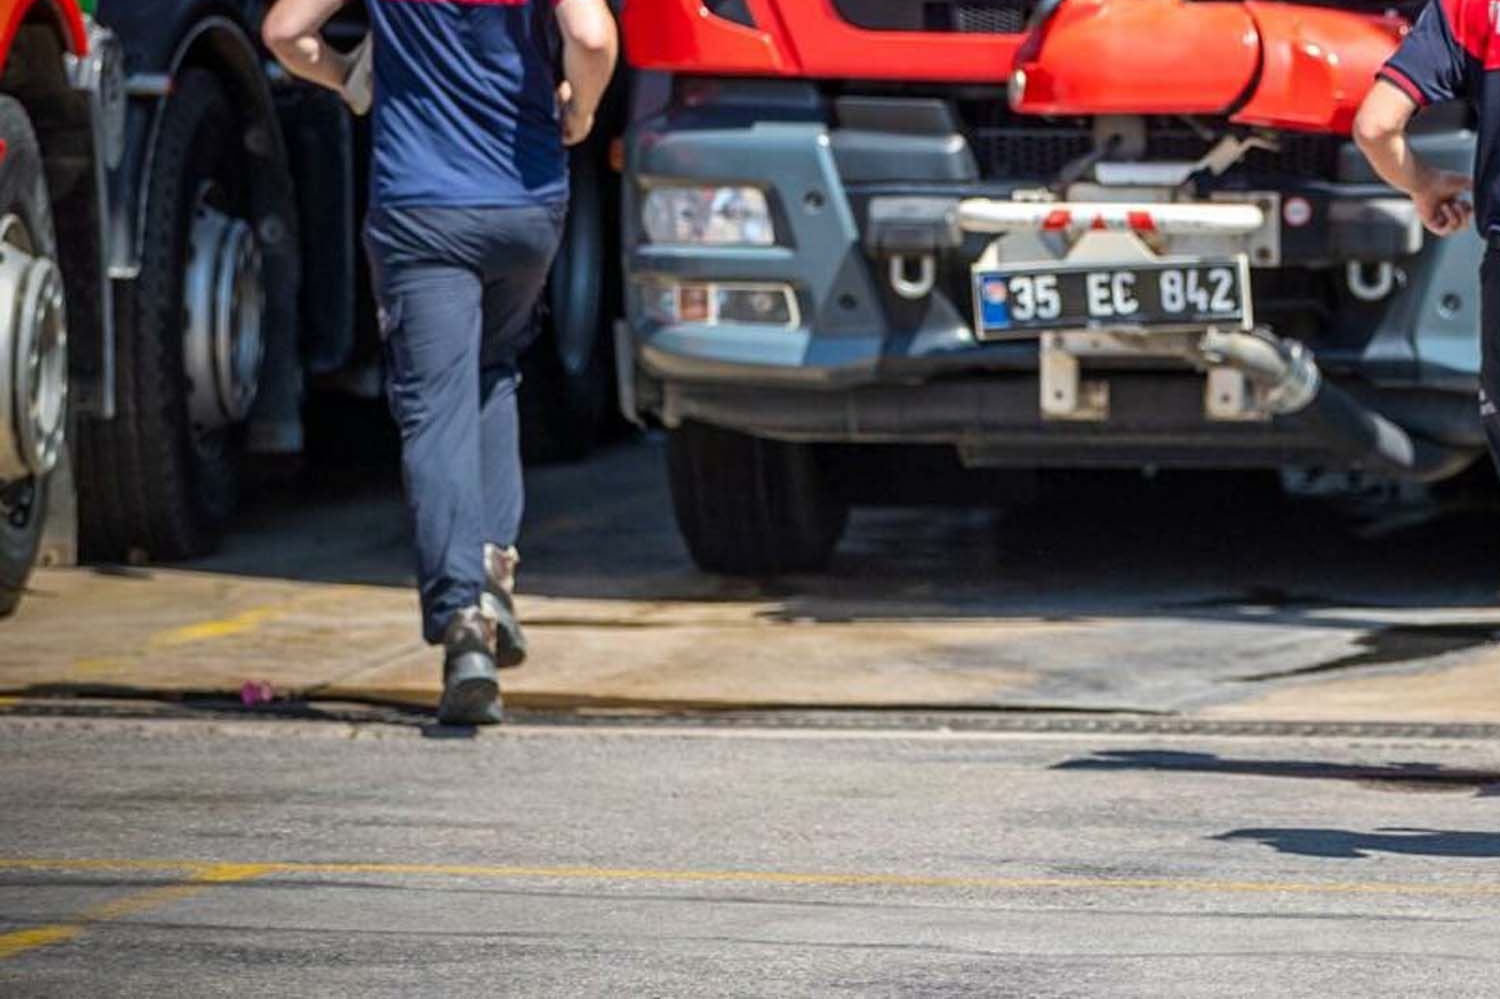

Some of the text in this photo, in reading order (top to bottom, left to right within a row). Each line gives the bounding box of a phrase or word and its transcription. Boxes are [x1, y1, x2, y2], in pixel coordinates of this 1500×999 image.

[1009, 269, 1236, 321] 35 EC 842
